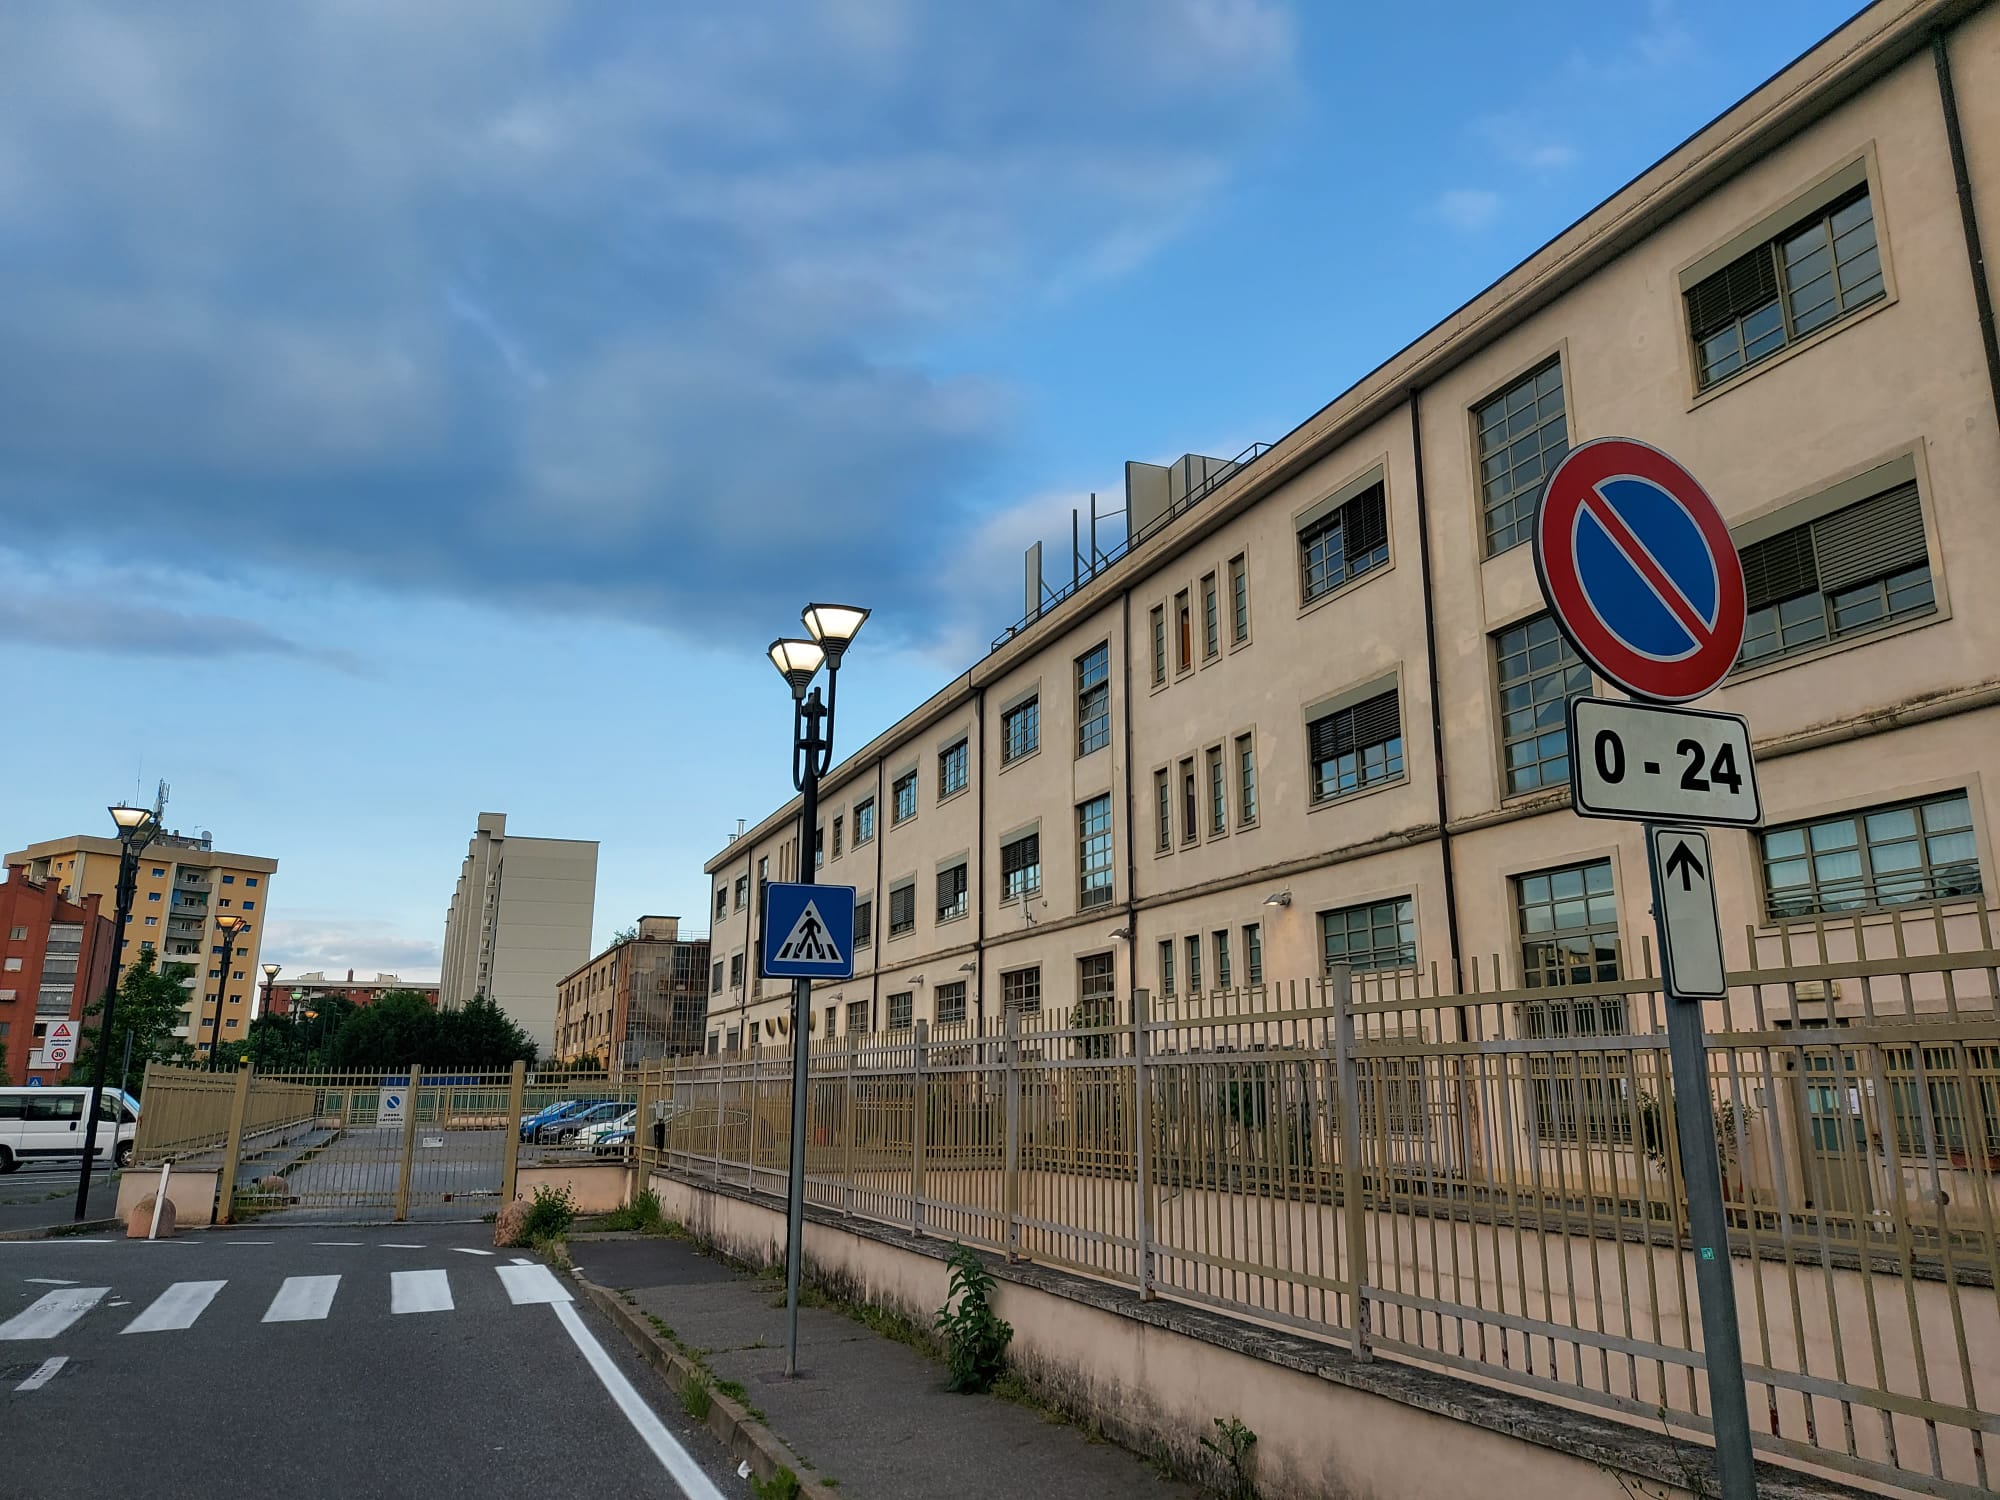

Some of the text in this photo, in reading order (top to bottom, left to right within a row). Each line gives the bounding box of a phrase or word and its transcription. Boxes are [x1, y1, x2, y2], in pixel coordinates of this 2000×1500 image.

[1594, 729, 1743, 795] 0 - 24
